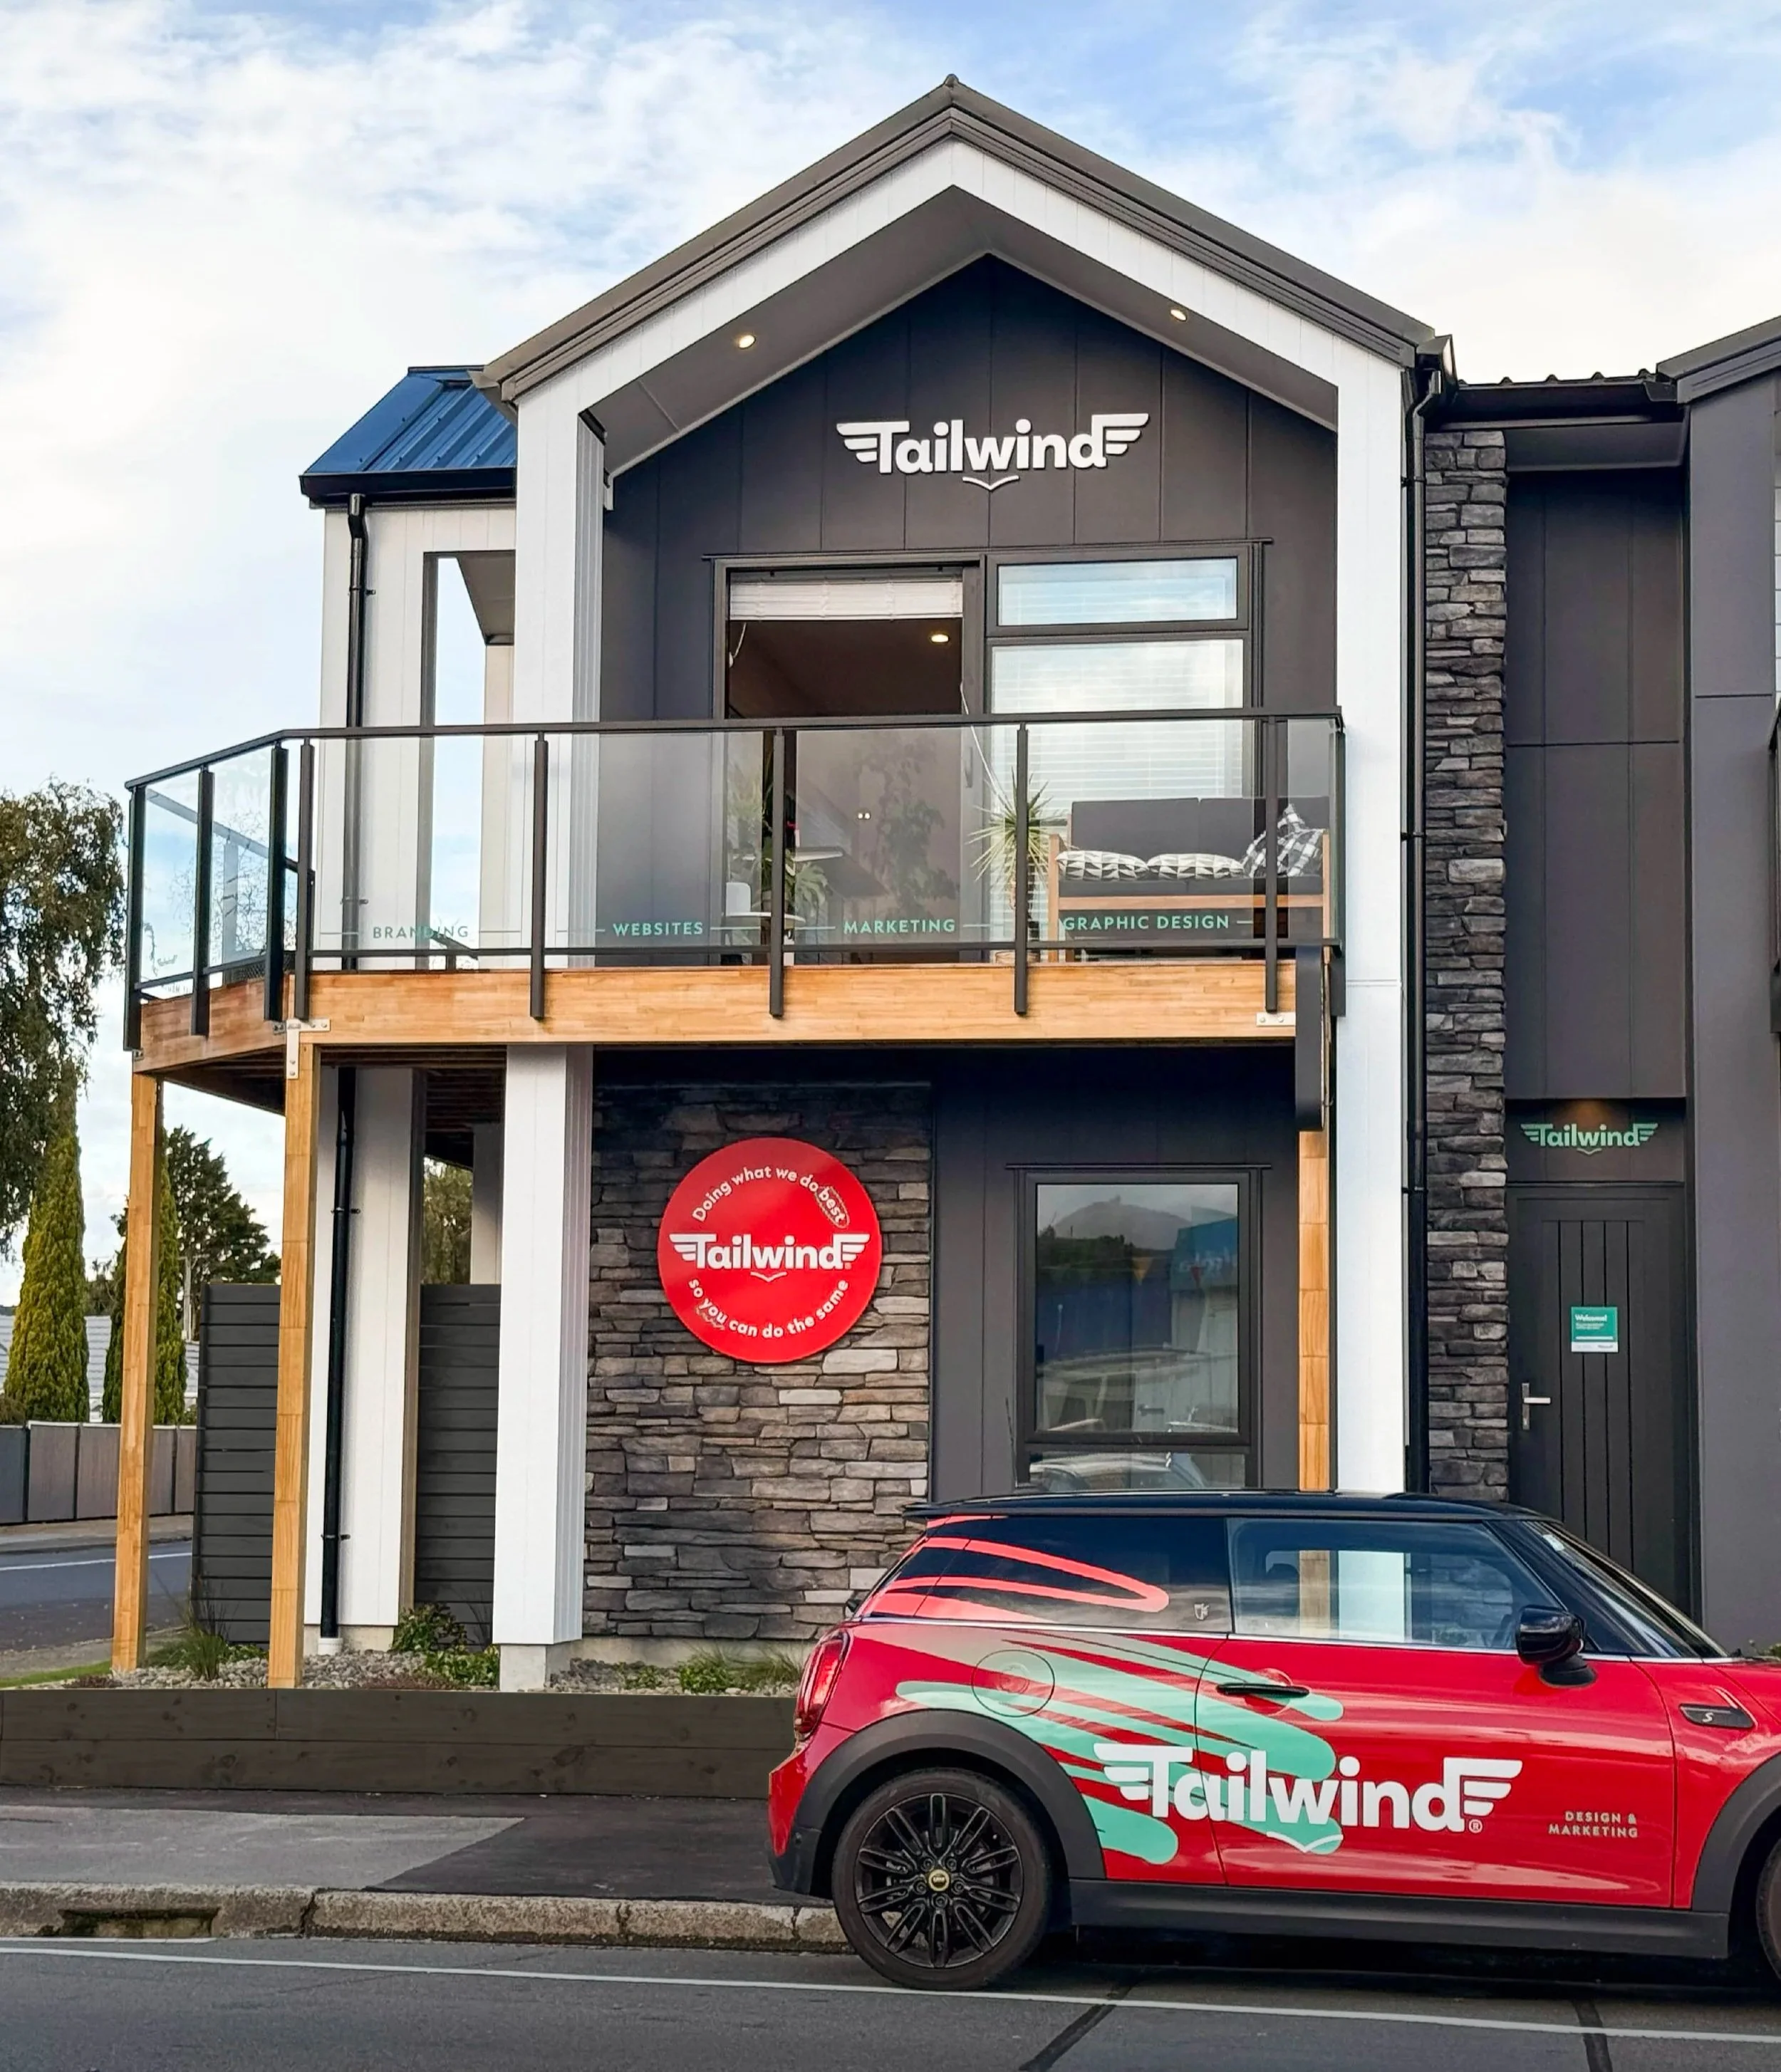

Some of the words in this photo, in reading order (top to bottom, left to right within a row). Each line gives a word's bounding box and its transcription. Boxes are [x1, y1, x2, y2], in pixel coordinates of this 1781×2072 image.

[836, 413, 1149, 474] Tailwind
[373, 925, 469, 939] BRANDING
[613, 922, 704, 937] WEBSITES
[843, 919, 955, 935] MARKETING
[1064, 916, 1149, 930] GRAPHIC
[1157, 915, 1230, 929] DESIGN
[1520, 1123, 1658, 1147] Tailwind
[692, 1181, 732, 1222] Doing
[732, 1165, 772, 1187] what
[776, 1167, 797, 1182] we
[799, 1174, 819, 1192] do
[819, 1186, 847, 1224] best
[688, 1279, 704, 1298] so
[699, 1297, 728, 1325] you
[729, 1320, 758, 1338] can
[762, 1323, 784, 1338] do
[786, 1316, 815, 1335] the
[816, 1279, 848, 1321] same
[1564, 1811, 1621, 1824] DESIGN
[1628, 1813, 1637, 1825] &
[1548, 1823, 1639, 1838] MARKETING
